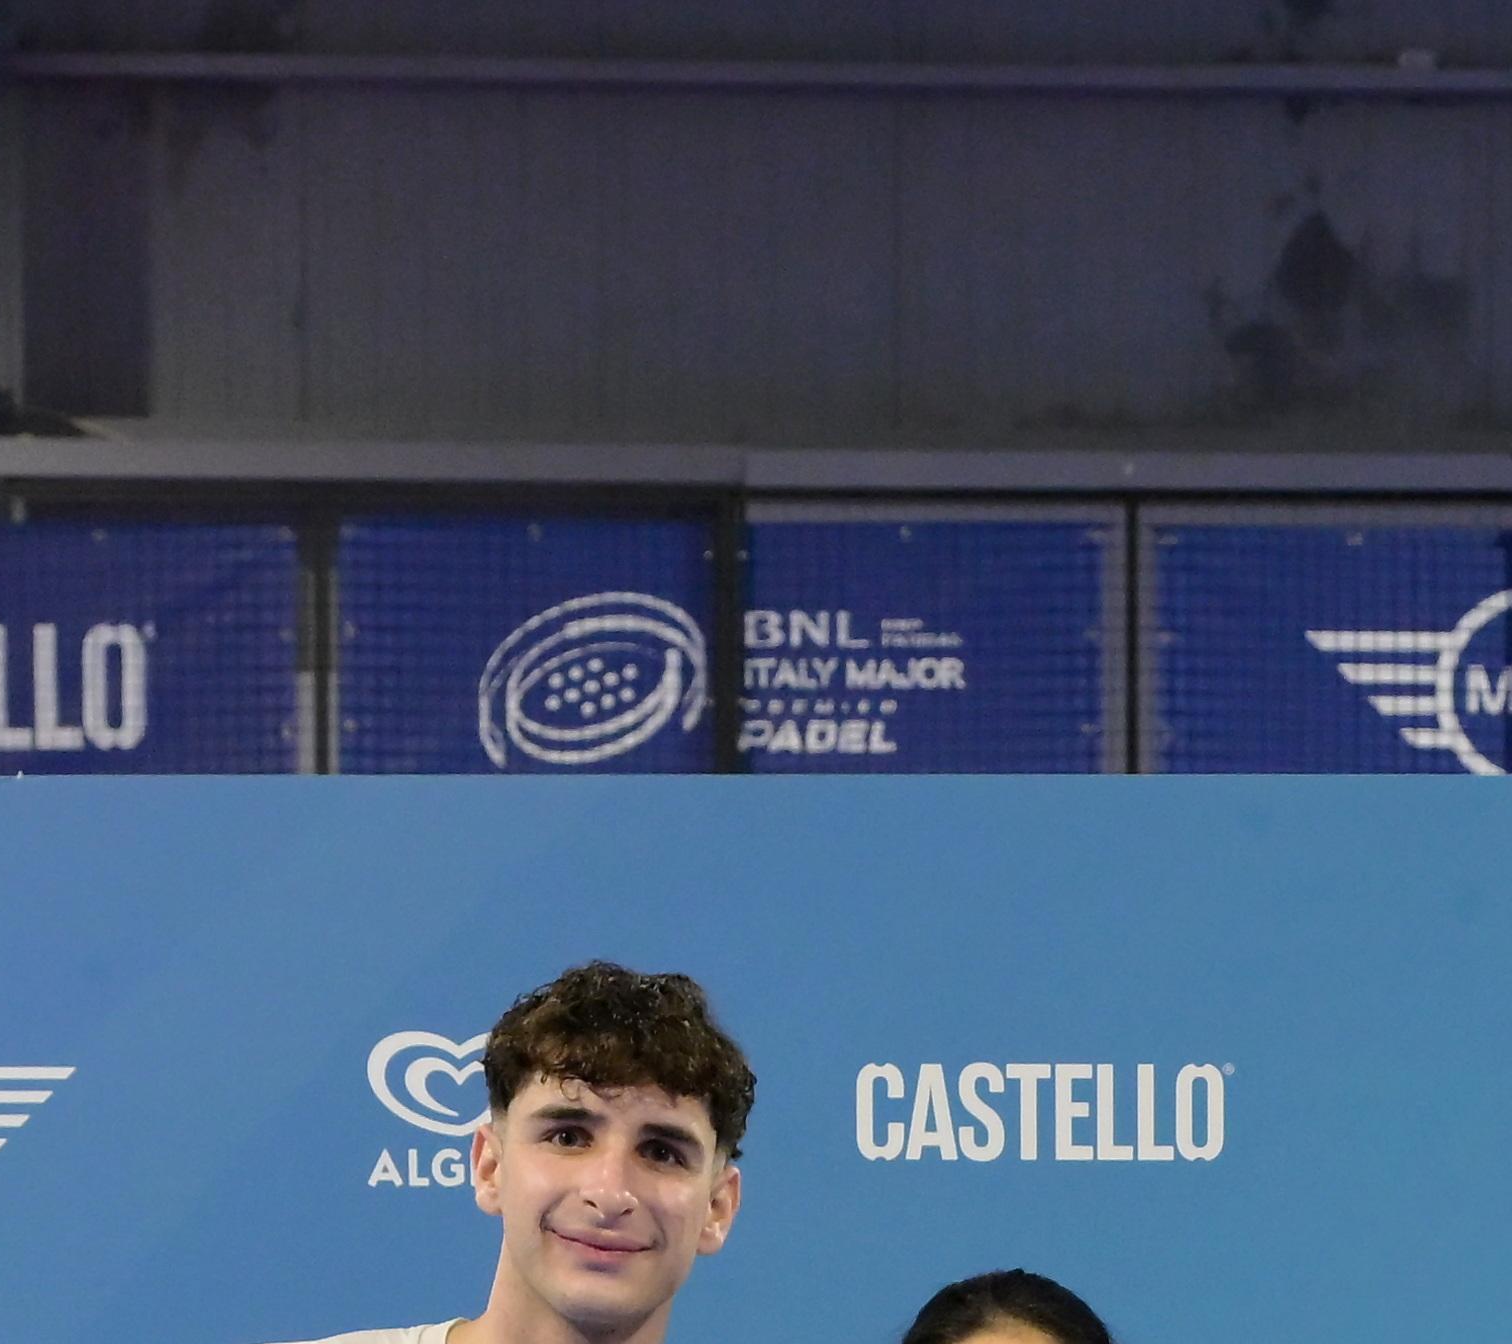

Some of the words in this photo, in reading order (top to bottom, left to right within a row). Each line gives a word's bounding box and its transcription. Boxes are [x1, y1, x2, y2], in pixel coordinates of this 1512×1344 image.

[743, 609, 870, 649] BNL
[743, 657, 838, 689] ITALY
[845, 656, 967, 690] MAJOR
[737, 719, 898, 753] PADEL
[368, 1148, 477, 1187] ALG
